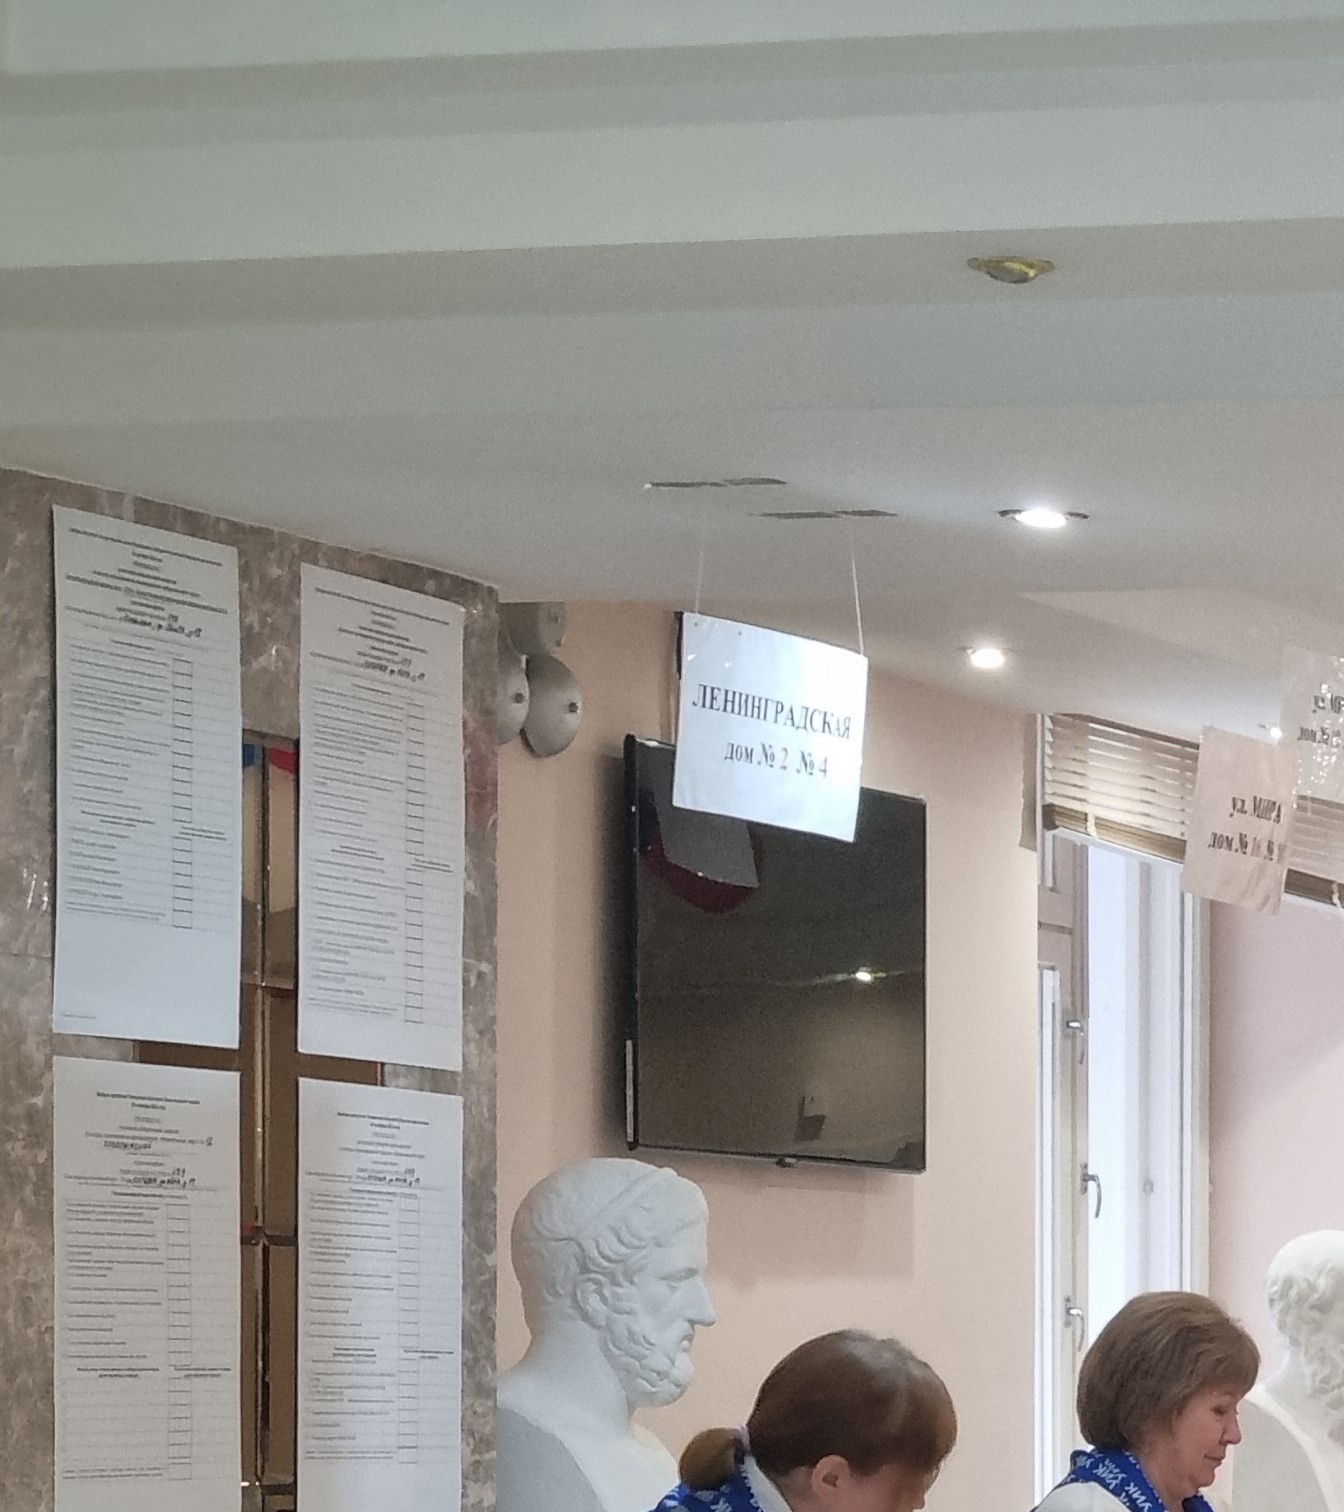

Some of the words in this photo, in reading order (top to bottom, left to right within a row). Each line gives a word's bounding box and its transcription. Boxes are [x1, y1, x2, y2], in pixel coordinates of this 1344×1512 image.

[691, 684, 852, 740] ЛЕНИНГРАДСКАЯ
[723, 742, 755, 766] дом
[757, 743, 776, 769] №
[779, 747, 789, 771] 2
[796, 750, 815, 776] №
[818, 756, 829, 779] 4
[1249, 795, 1282, 824] МИРА
